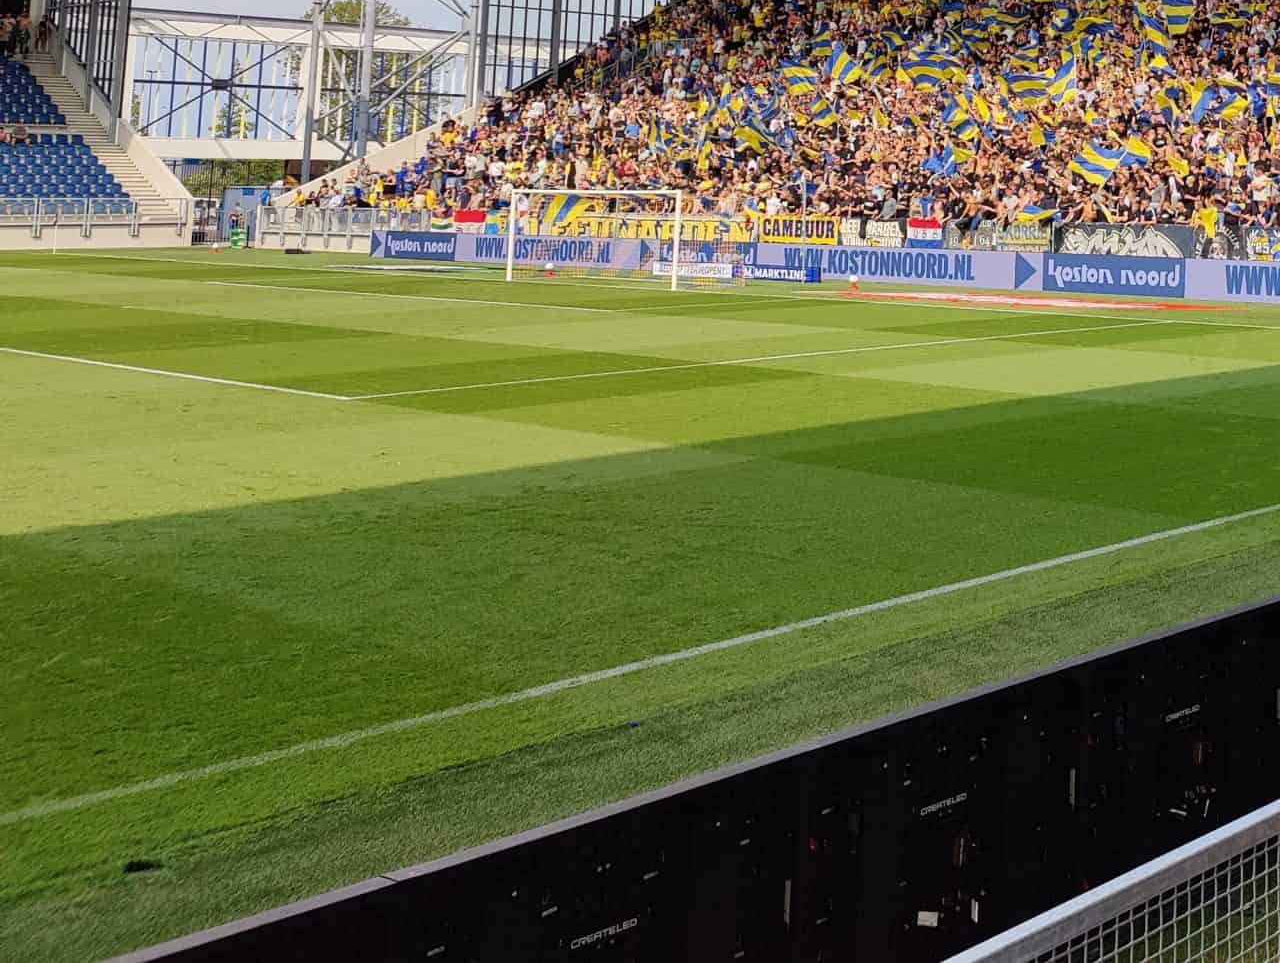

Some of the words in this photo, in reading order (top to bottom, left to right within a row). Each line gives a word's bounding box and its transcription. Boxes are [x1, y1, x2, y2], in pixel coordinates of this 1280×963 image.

[762, 218, 835, 238] CAMBUUR
[424, 235, 455, 254] noord
[784, 246, 975, 282] WWW.KOSTONNOORD.NL
[1047, 258, 1114, 288] koston
[1120, 264, 1181, 287] noord
[570, 917, 638, 950] CREATELED
